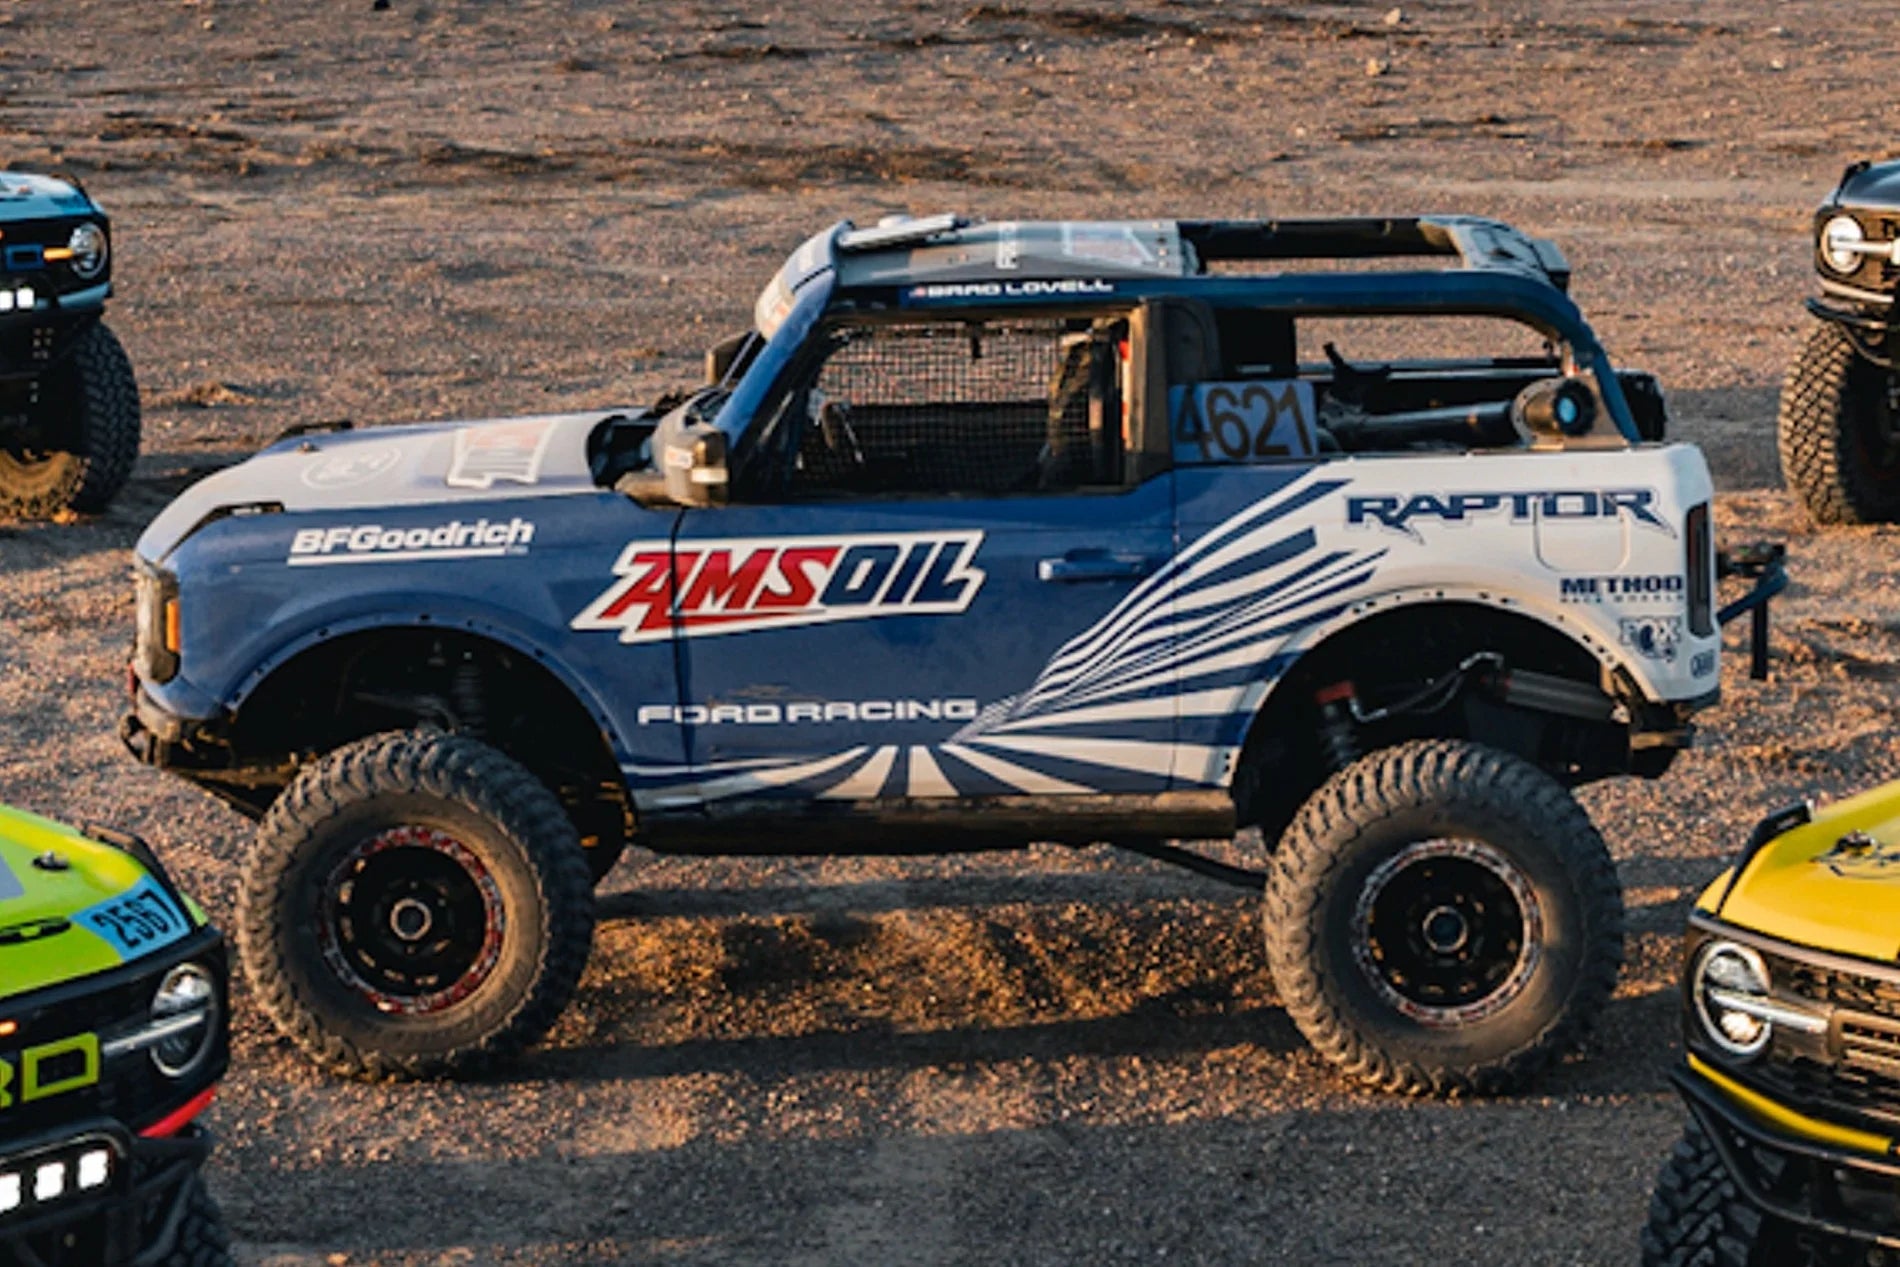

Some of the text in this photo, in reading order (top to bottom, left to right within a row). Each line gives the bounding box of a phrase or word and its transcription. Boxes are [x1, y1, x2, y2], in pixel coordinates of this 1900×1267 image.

[928, 278, 1115, 298] BRAD LOVELL
[1173, 383, 1314, 460] 4621
[290, 517, 536, 554] BFGoodrich
[1346, 490, 1679, 545] RAPTOR
[595, 538, 974, 634] AMSOIL
[1560, 576, 1684, 594] METHOD
[637, 699, 979, 726] FORD RACING
